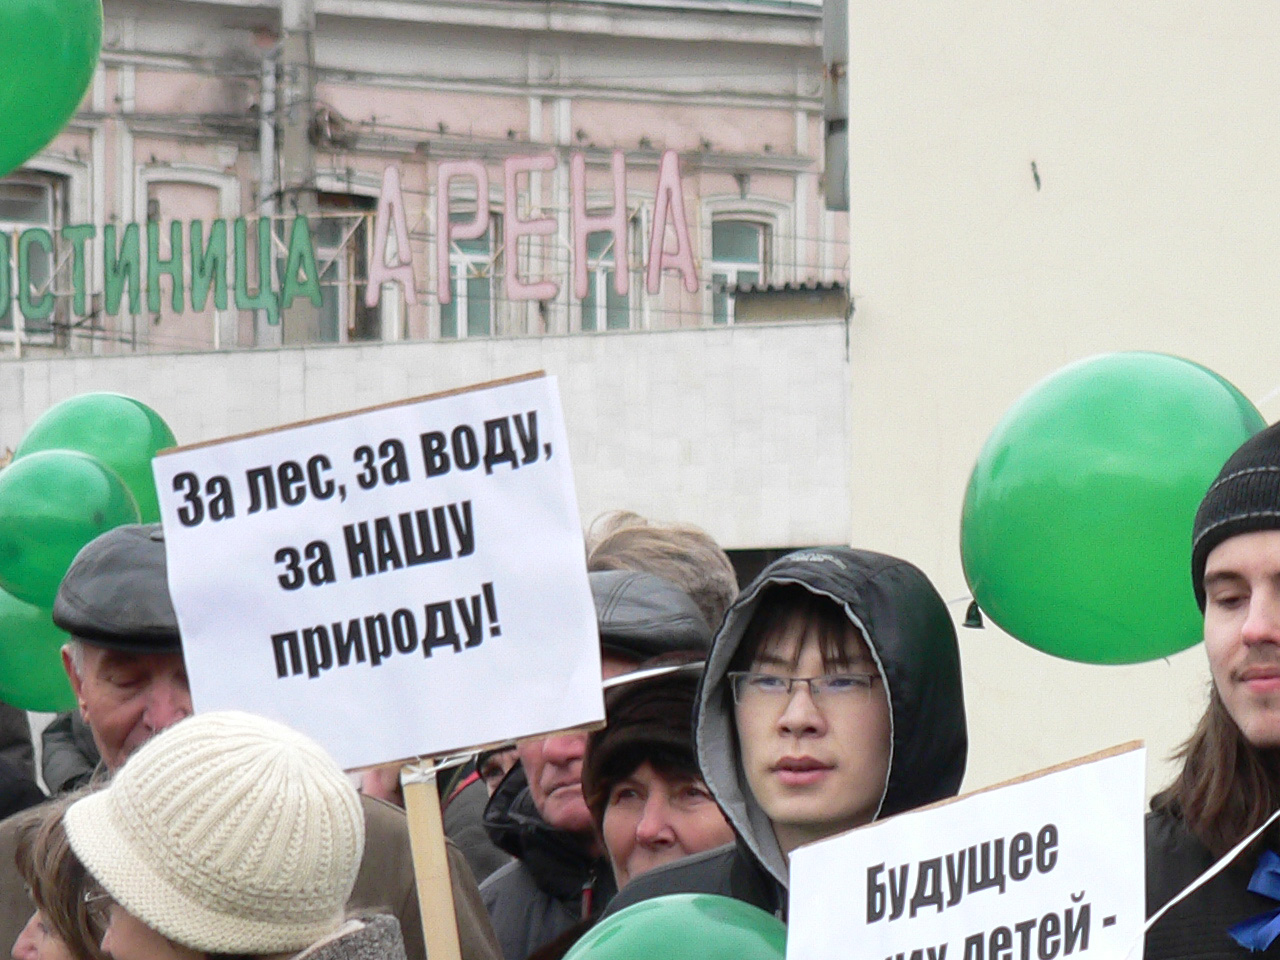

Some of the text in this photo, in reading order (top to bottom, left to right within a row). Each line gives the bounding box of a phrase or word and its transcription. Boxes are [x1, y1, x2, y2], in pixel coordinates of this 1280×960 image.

[0, 150, 698, 325] СТИНИЦА АРЕНА
[172, 410, 553, 527] За лес, за воду,
[274, 500, 475, 591] за НАШУ
[271, 582, 501, 679] природу!
[866, 823, 1059, 925] Будущее
[1102, 914, 1117, 928] -
